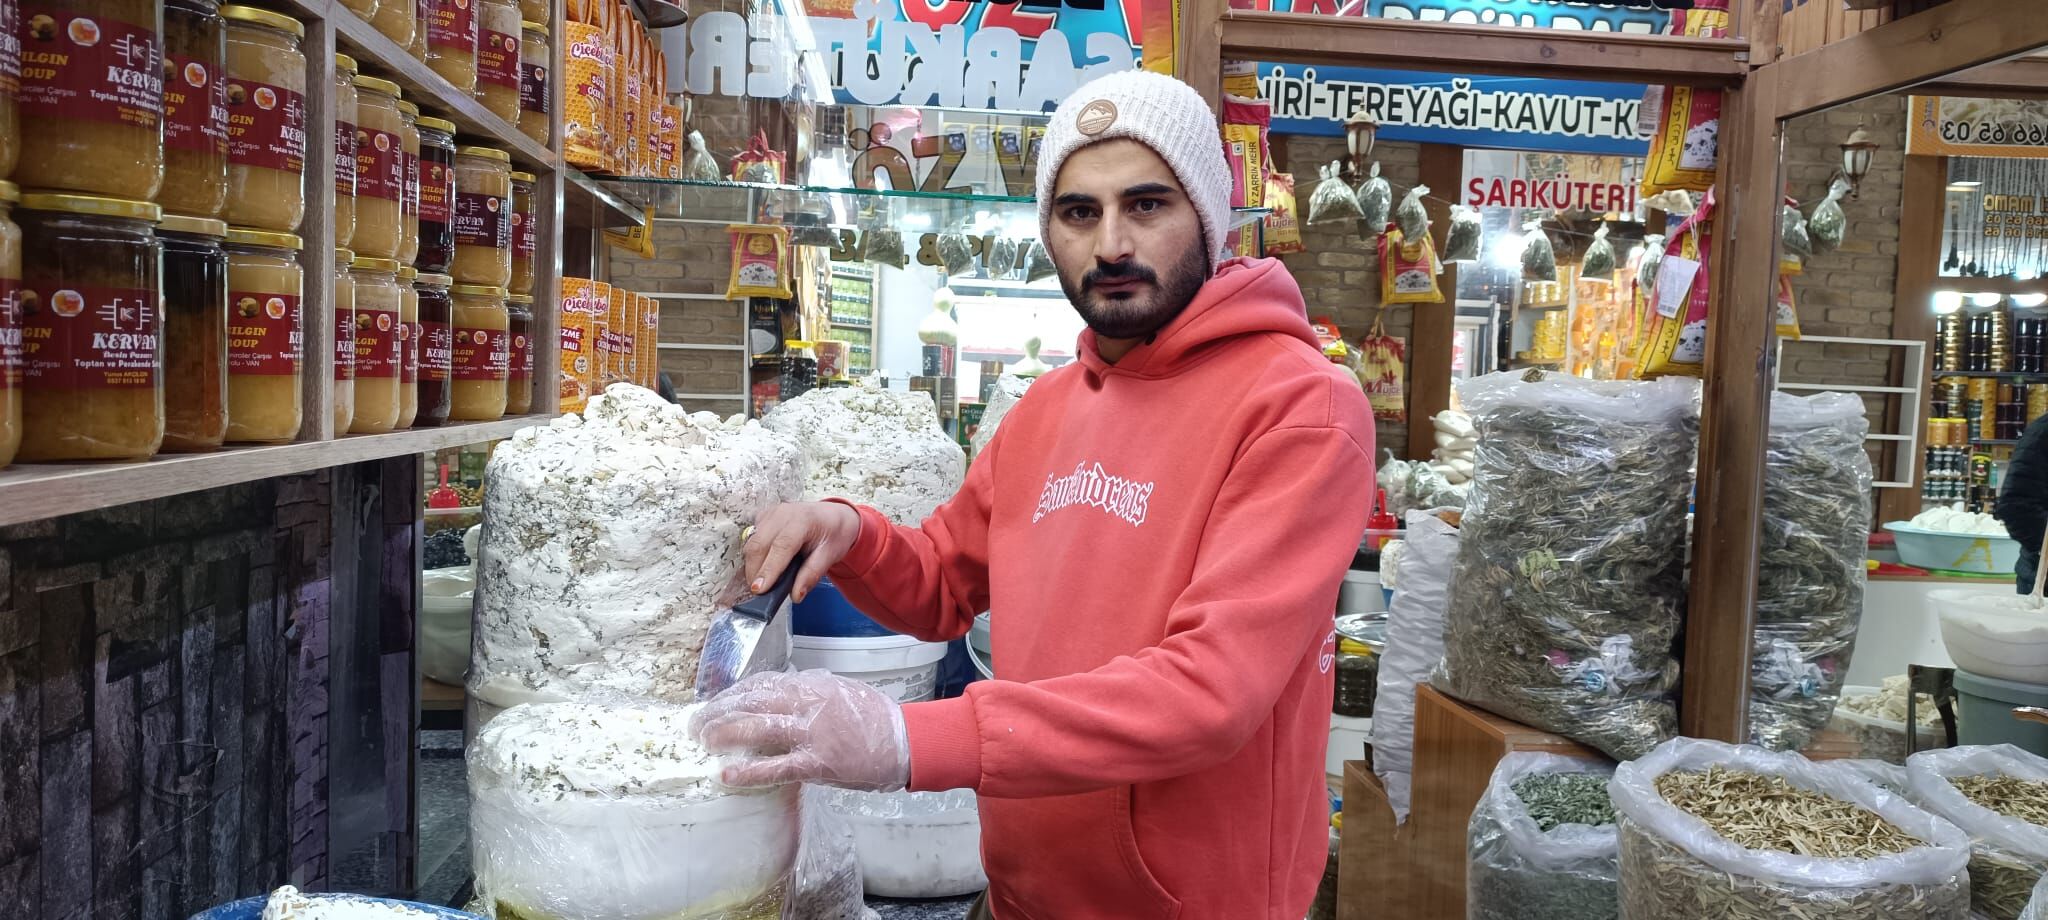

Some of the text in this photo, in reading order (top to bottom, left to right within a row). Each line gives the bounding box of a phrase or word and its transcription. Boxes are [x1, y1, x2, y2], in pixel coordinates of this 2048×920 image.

[1468, 174, 1636, 213] ŞARKÜTERİ
[92, 332, 157, 351] KERVAN
[74, 359, 105, 370] Toptan
